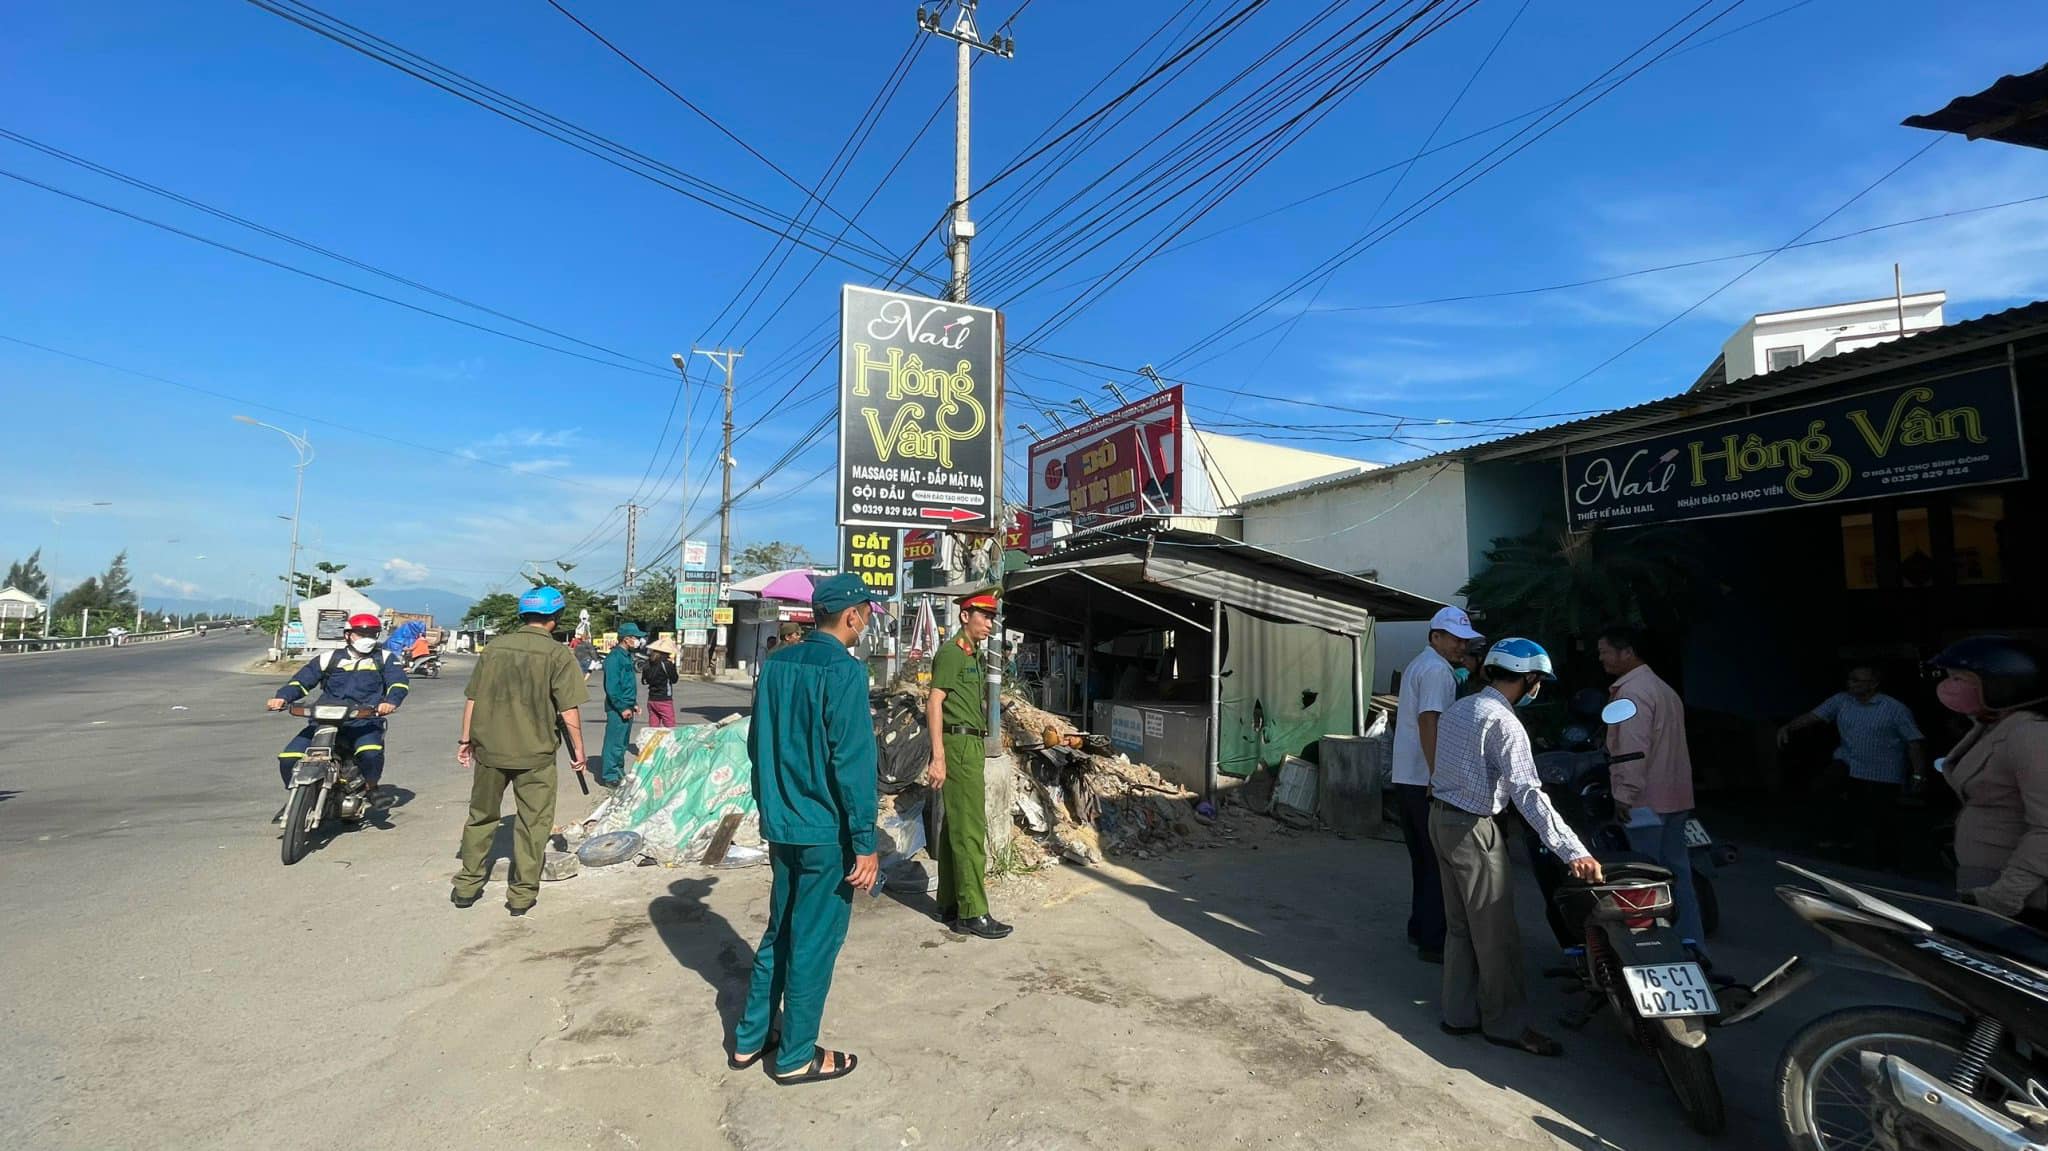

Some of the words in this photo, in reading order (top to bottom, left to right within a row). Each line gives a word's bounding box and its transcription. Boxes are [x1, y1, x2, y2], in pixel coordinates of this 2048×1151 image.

[868, 300, 970, 350] Nail
[861, 402, 953, 468] Vân
[1575, 449, 1676, 505] Nail
[1845, 387, 1989, 458] Vân
[852, 465, 898, 481] MASSAGE
[900, 467, 920, 486] MẶT
[1891, 473, 1919, 484] 0329
[1922, 470, 1943, 480] 829
[1946, 466, 1969, 475] 824
[852, 484, 876, 500] GỘI
[862, 505, 883, 515] 0329
[885, 505, 900, 516] 829
[902, 506, 917, 516] 824
[1633, 504, 1655, 514] NAIL
[851, 532, 890, 550] CẮT
[851, 551, 891, 568] TÓC
[848, 571, 894, 586] AM
[1636, 966, 1693, 989] 76-C1
[1640, 989, 1710, 1013] 402.57
